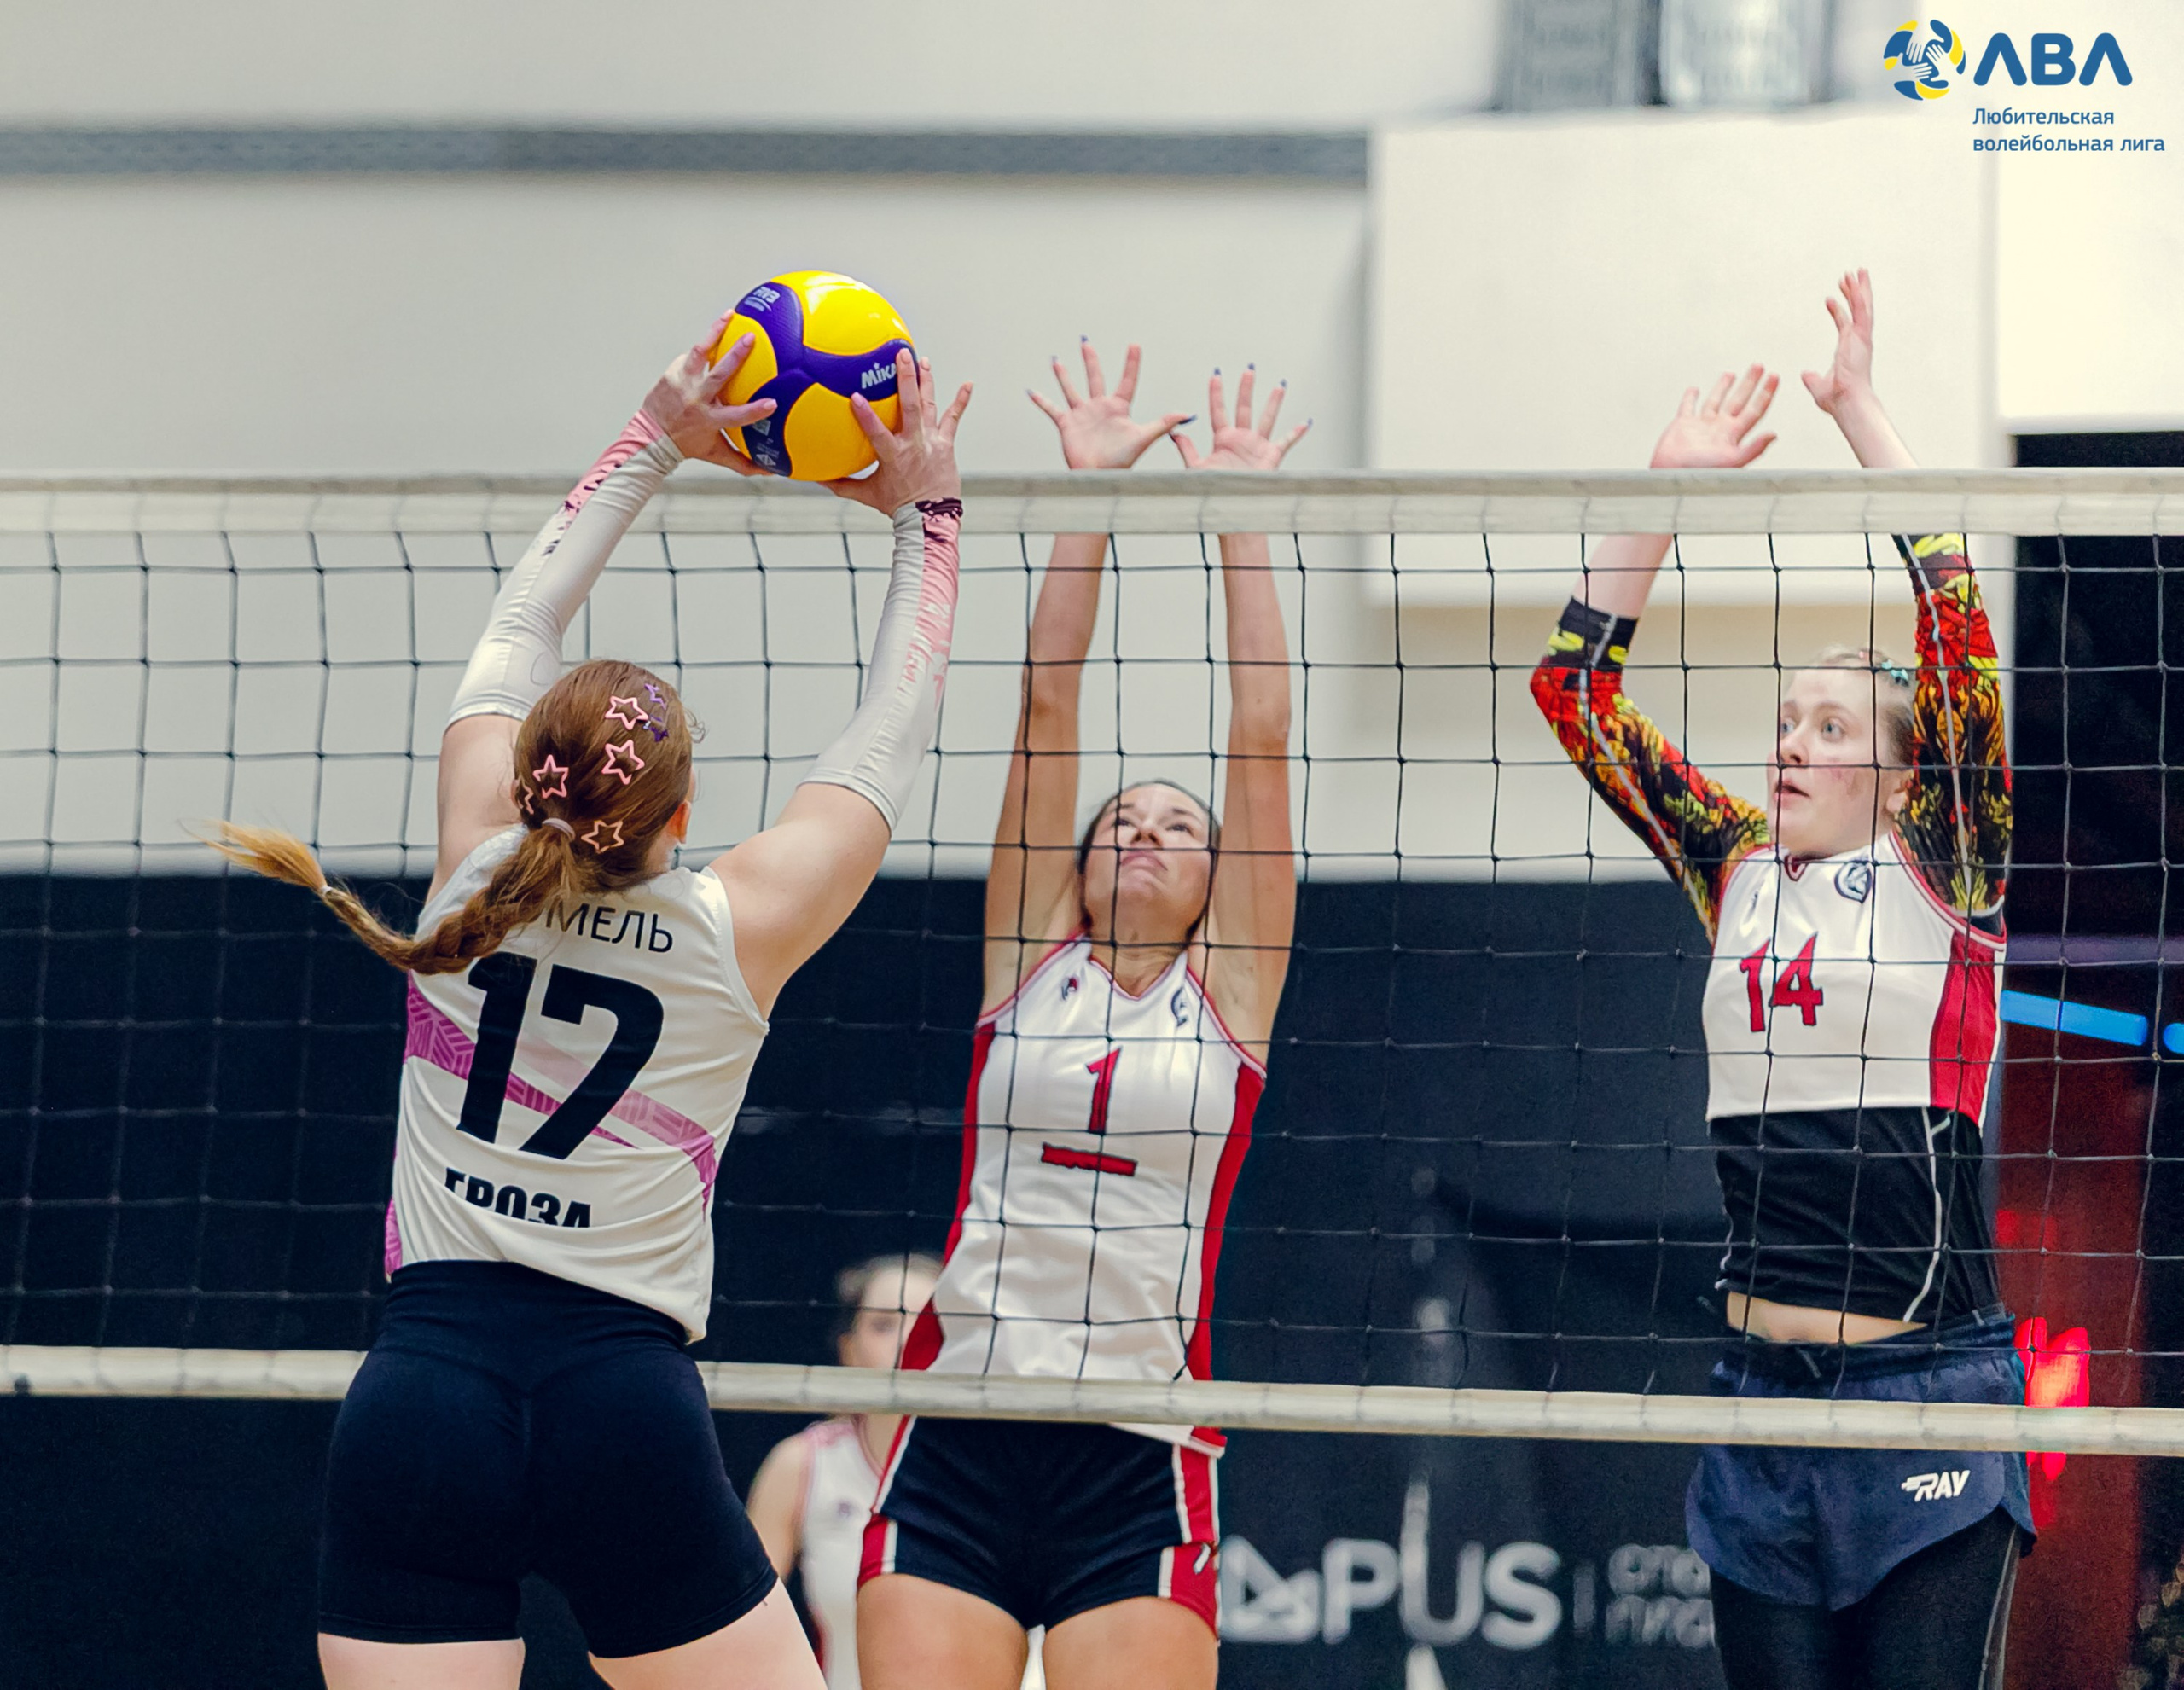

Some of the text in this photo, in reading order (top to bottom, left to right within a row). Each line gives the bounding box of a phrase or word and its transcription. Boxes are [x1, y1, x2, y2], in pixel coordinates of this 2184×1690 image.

[545, 897, 673, 953] МЕЛЬ
[1740, 932, 1823, 1032] 14
[456, 951, 664, 1159] 17
[1086, 1046, 1123, 1134] 1
[444, 1167, 591, 1228] ГРОЗА
[1901, 1469, 1971, 1502] RAY
